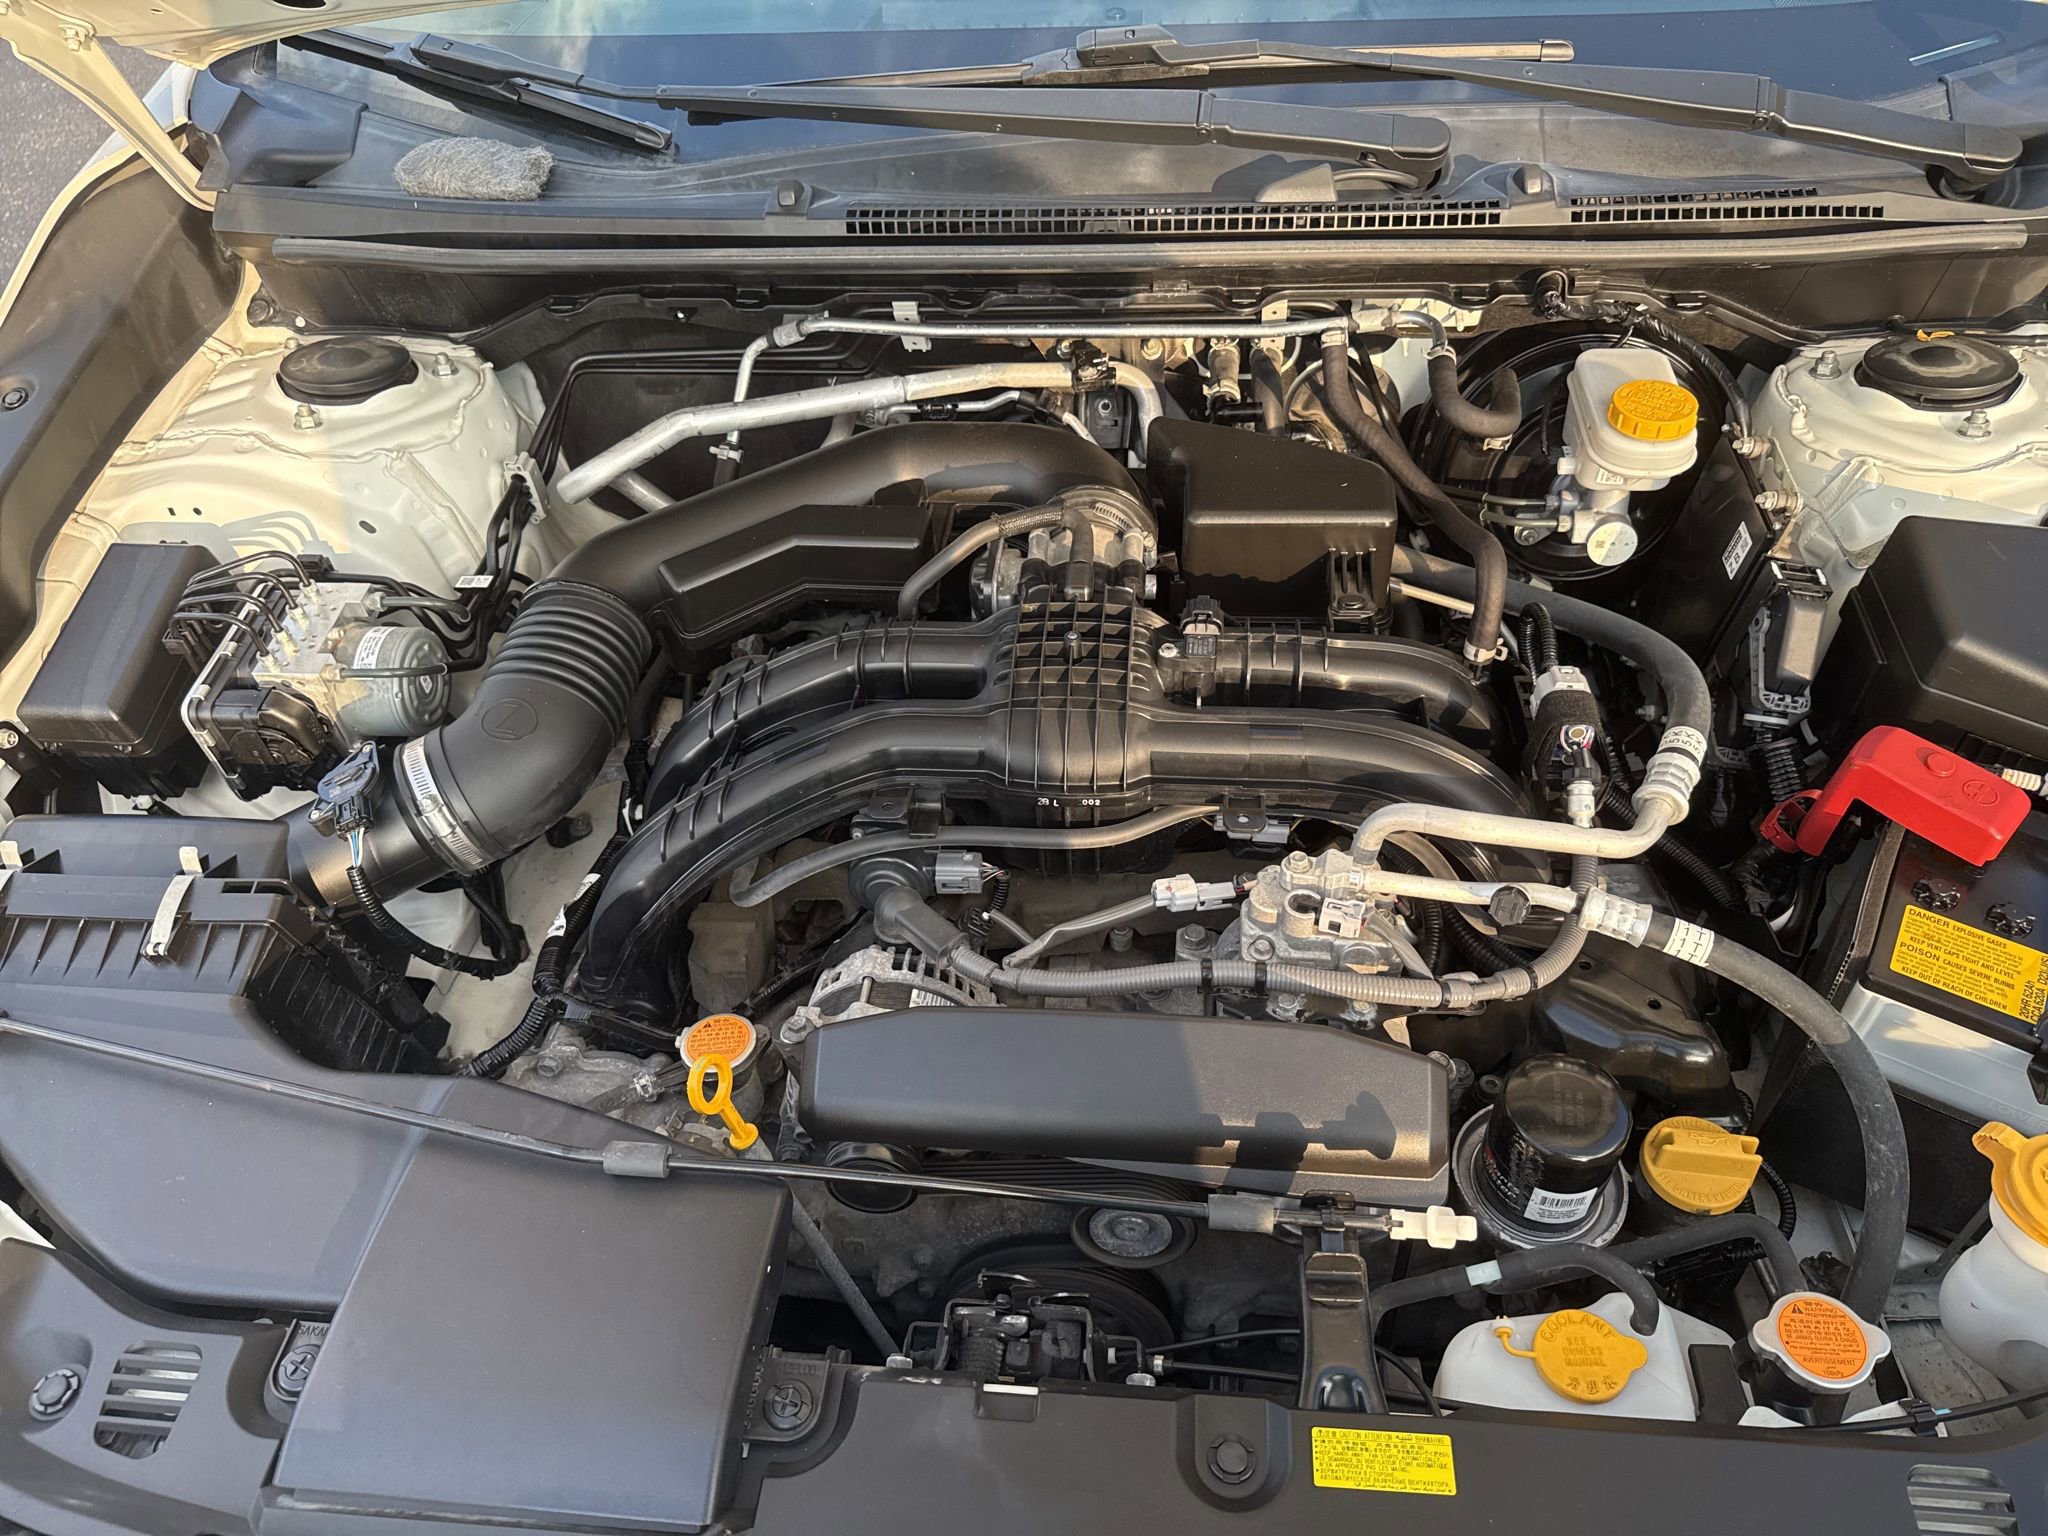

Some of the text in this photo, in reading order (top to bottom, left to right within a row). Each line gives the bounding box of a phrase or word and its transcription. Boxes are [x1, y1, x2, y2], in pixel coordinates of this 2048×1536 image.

[1908, 908, 2007, 949] DANGER EXPLOSIVE GASES
[1900, 941, 2016, 990] POISON CAUSES SEVERE BURNS
[1909, 936, 2015, 980] KEEP VENT CAPS TIGHT AND LEVEL
[1902, 966, 2008, 1011] KEEP OUT OF REACH OF CHILDREN
[2030, 1004, 2042, 1023] CCA
[1657, 1172, 1674, 1187] SEE
[1540, 1313, 1618, 1343] COOLANT
